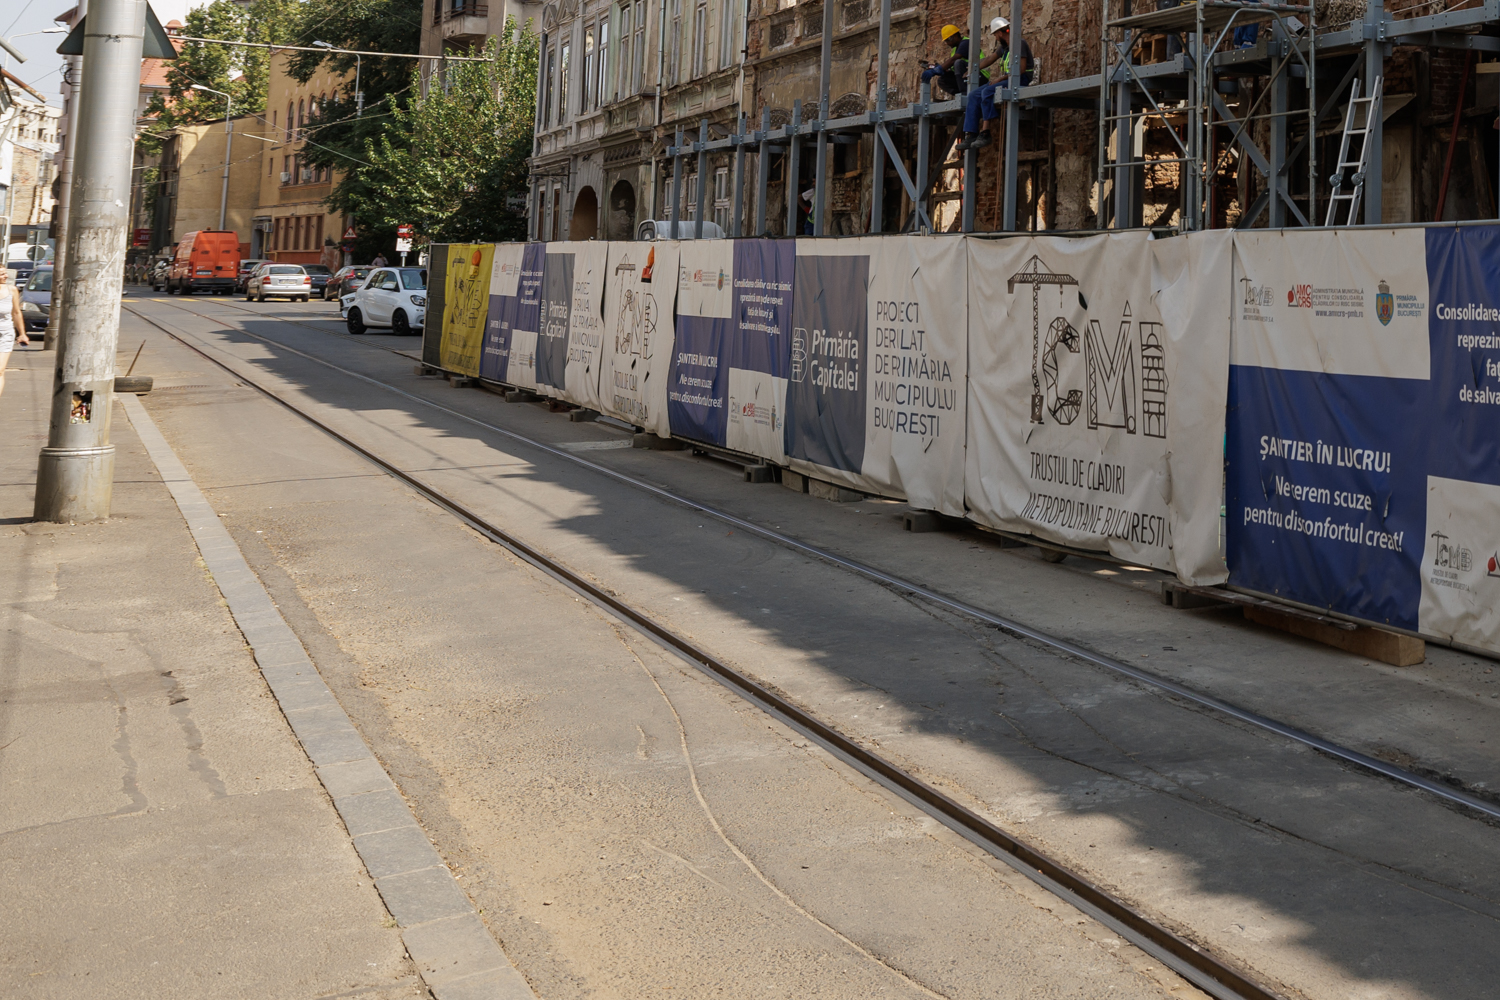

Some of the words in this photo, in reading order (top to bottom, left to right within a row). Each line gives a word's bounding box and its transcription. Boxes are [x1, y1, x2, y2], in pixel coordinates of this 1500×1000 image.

[811, 329, 859, 359] Primăria
[810, 359, 859, 394] Capitalei
[875, 354, 889, 376] DE
[874, 380, 957, 411] MUNCIPIULUI
[1459, 385, 1472, 402] de
[1260, 435, 1314, 463] ȘANTIER
[1316, 439, 1333, 465] ÎN
[1337, 446, 1391, 473] LUCRU!
[1030, 451, 1069, 486] TRUSTUL
[1072, 458, 1084, 488] DE
[1087, 461, 1125, 494] CLADIRI
[1275, 475, 1291, 497] Ne
[1333, 490, 1372, 511] scuze
[1020, 492, 1104, 534] METROPOLITANE
[1100, 507, 1165, 548] BUCURESTI
[1244, 506, 1283, 527] pentru
[1284, 509, 1364, 544] disconfortul
[1365, 529, 1404, 552] creat!
